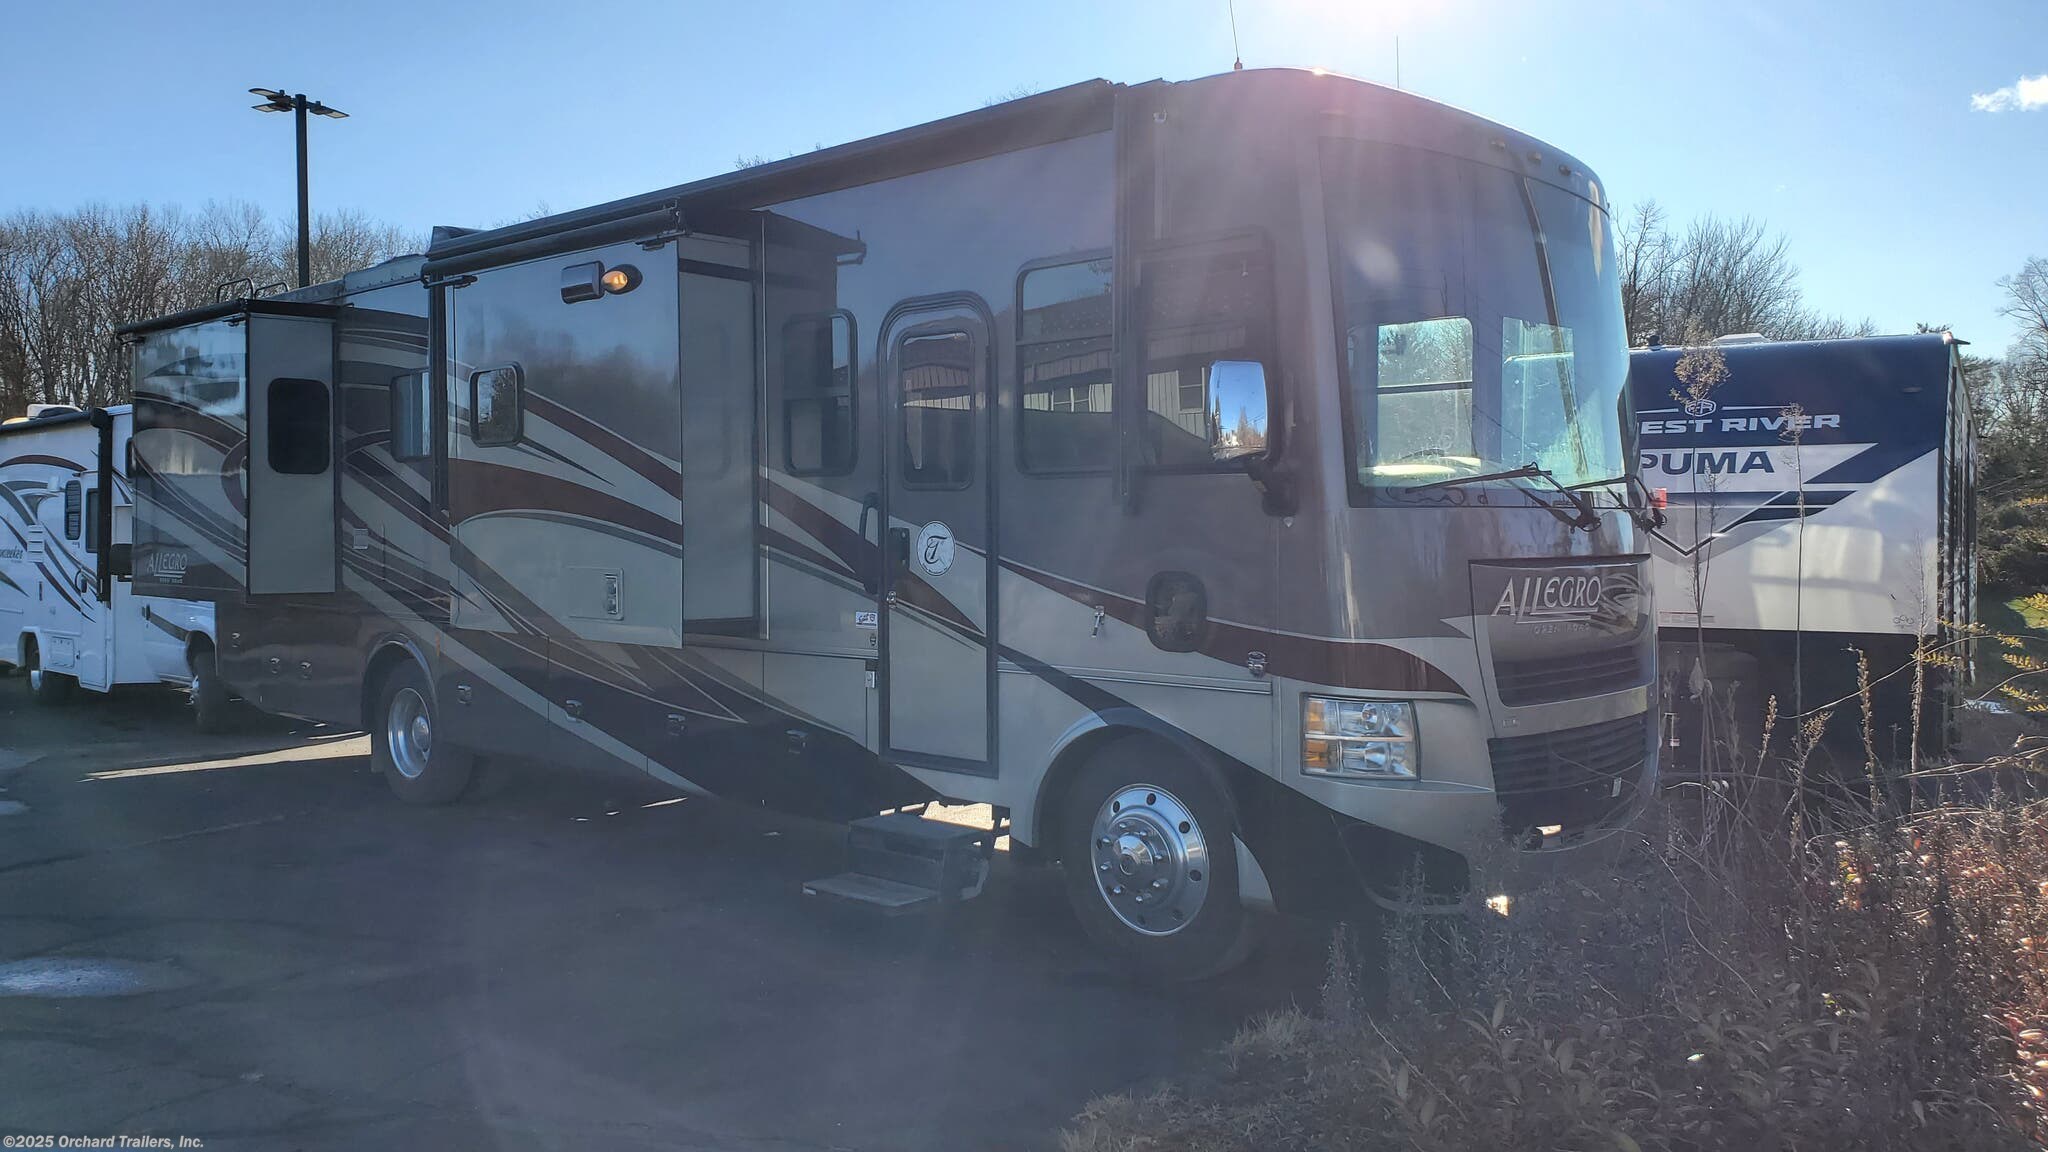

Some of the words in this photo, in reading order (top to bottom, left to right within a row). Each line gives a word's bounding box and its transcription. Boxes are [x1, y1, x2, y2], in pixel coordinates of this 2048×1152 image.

[1640, 419, 1713, 435] EST
[1720, 413, 1841, 433] RIVER
[1640, 451, 1775, 475] PUMA
[147, 552, 187, 577] ALLEGRO
[1490, 575, 1602, 624] ALLEGRO
